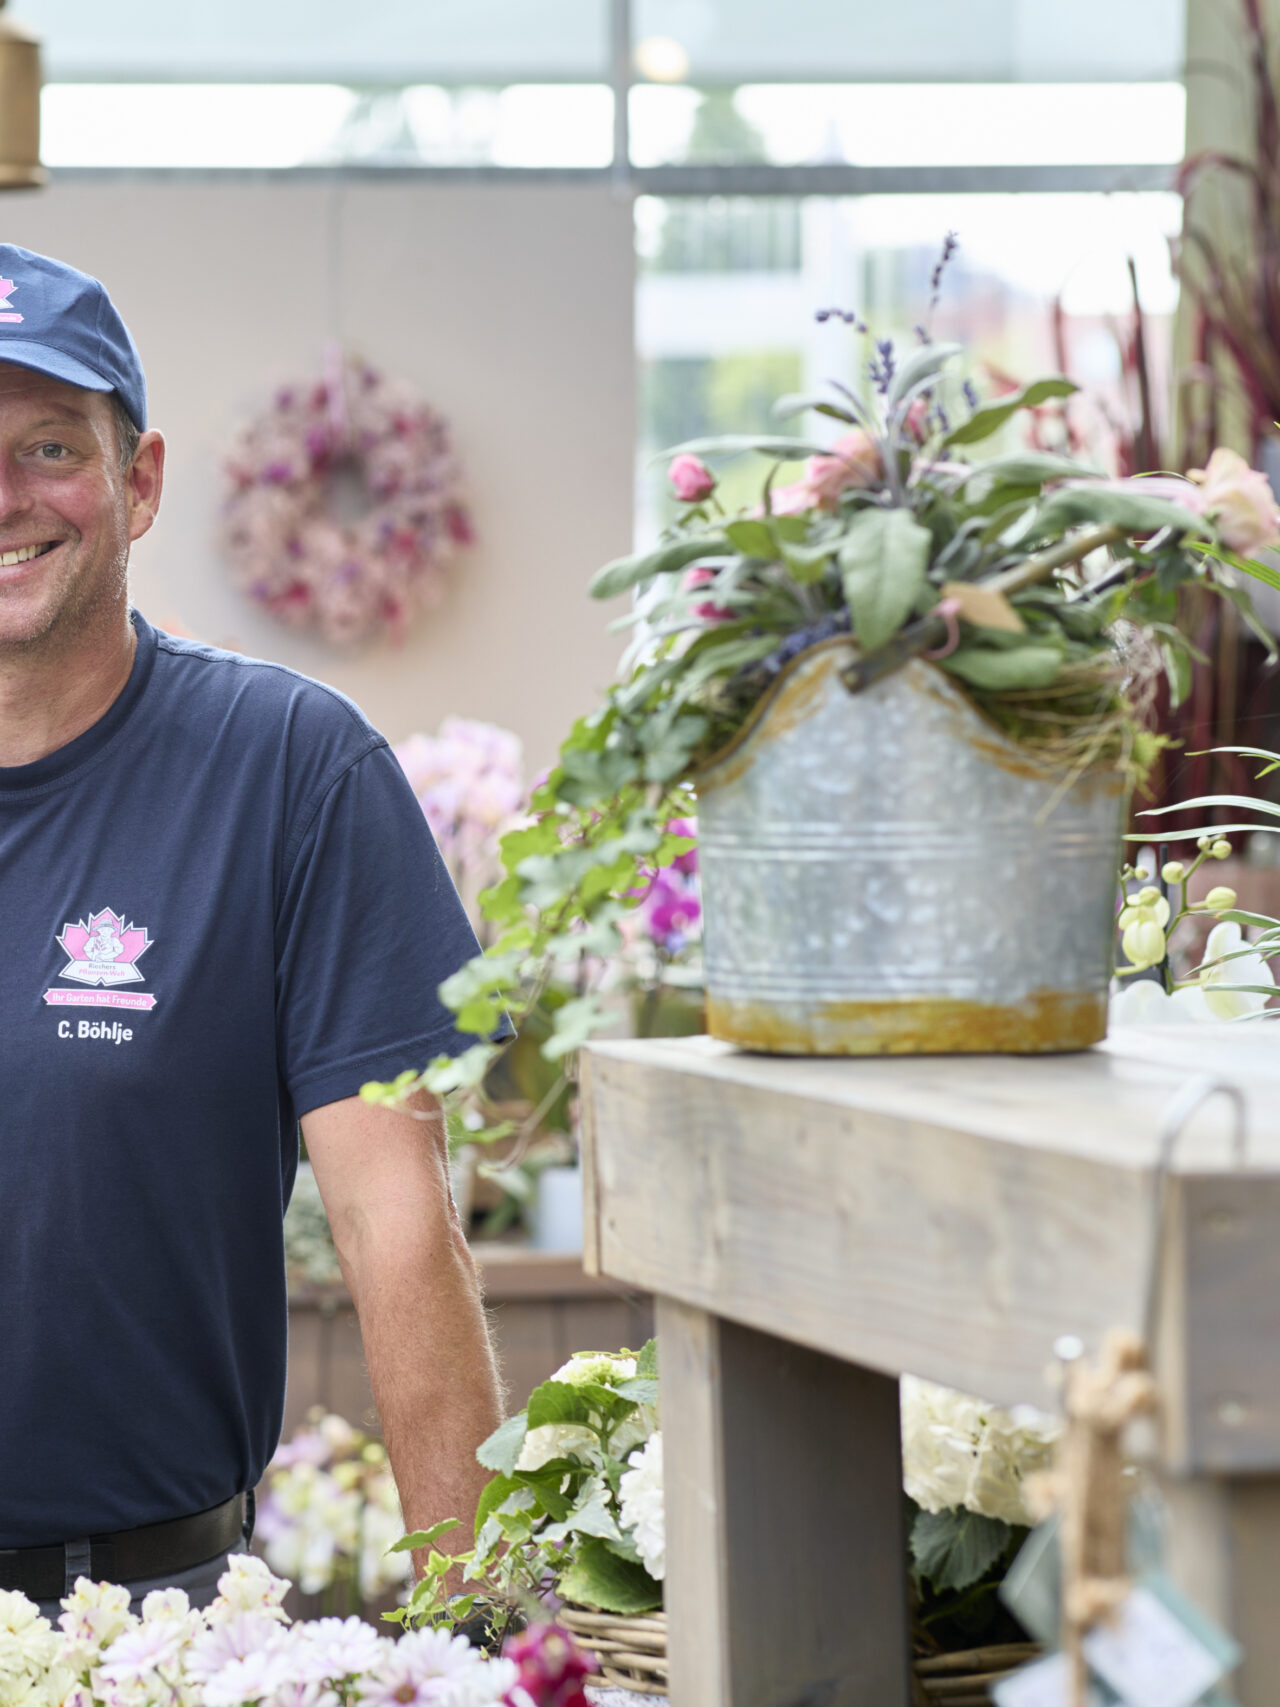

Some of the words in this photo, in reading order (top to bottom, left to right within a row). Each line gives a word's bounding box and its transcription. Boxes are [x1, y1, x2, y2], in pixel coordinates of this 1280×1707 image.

[52, 992, 65, 1002] Ihr
[66, 993, 95, 1003] Garten
[96, 993, 110, 1004] hat
[112, 994, 147, 1006] Freunde
[58, 1020, 74, 1038] C.
[78, 1020, 133, 1045] Böhlje
